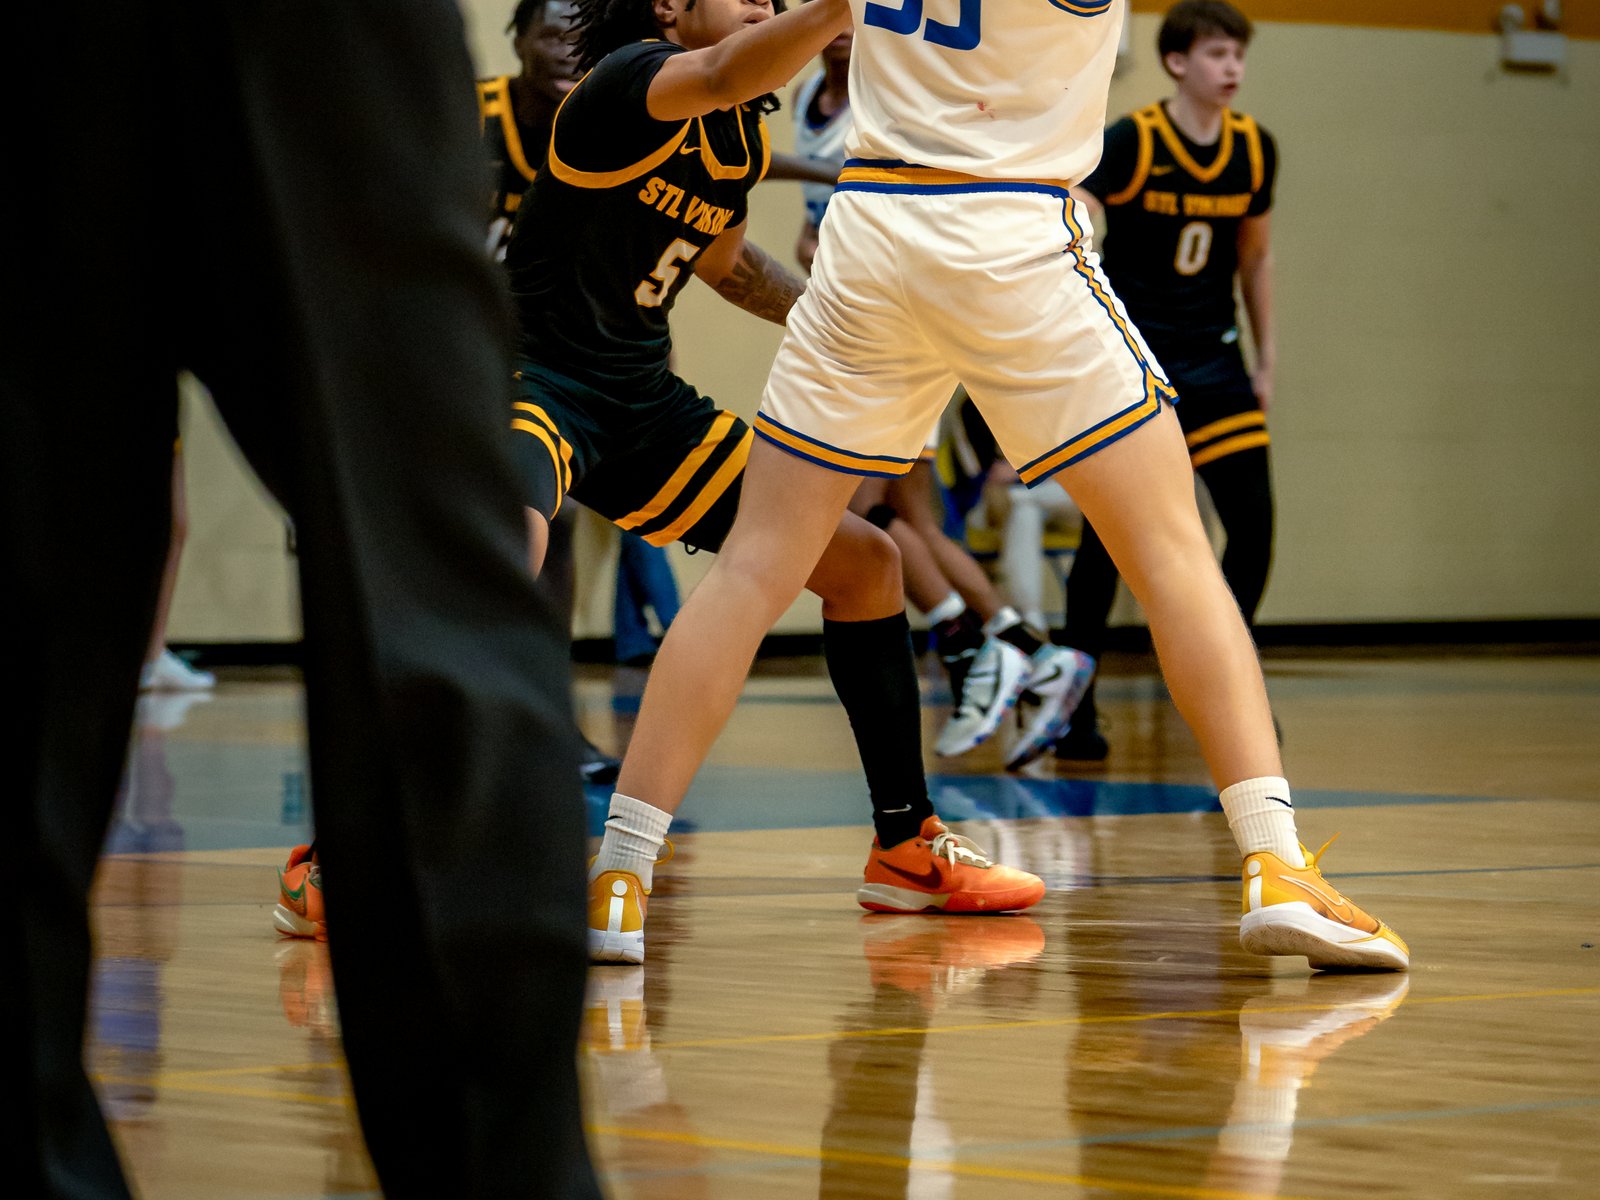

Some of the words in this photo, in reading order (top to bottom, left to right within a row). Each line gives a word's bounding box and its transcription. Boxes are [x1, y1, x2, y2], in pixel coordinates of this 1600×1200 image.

[639, 176, 685, 219] STL
[634, 237, 701, 308] 5
[1173, 220, 1214, 277] 0
